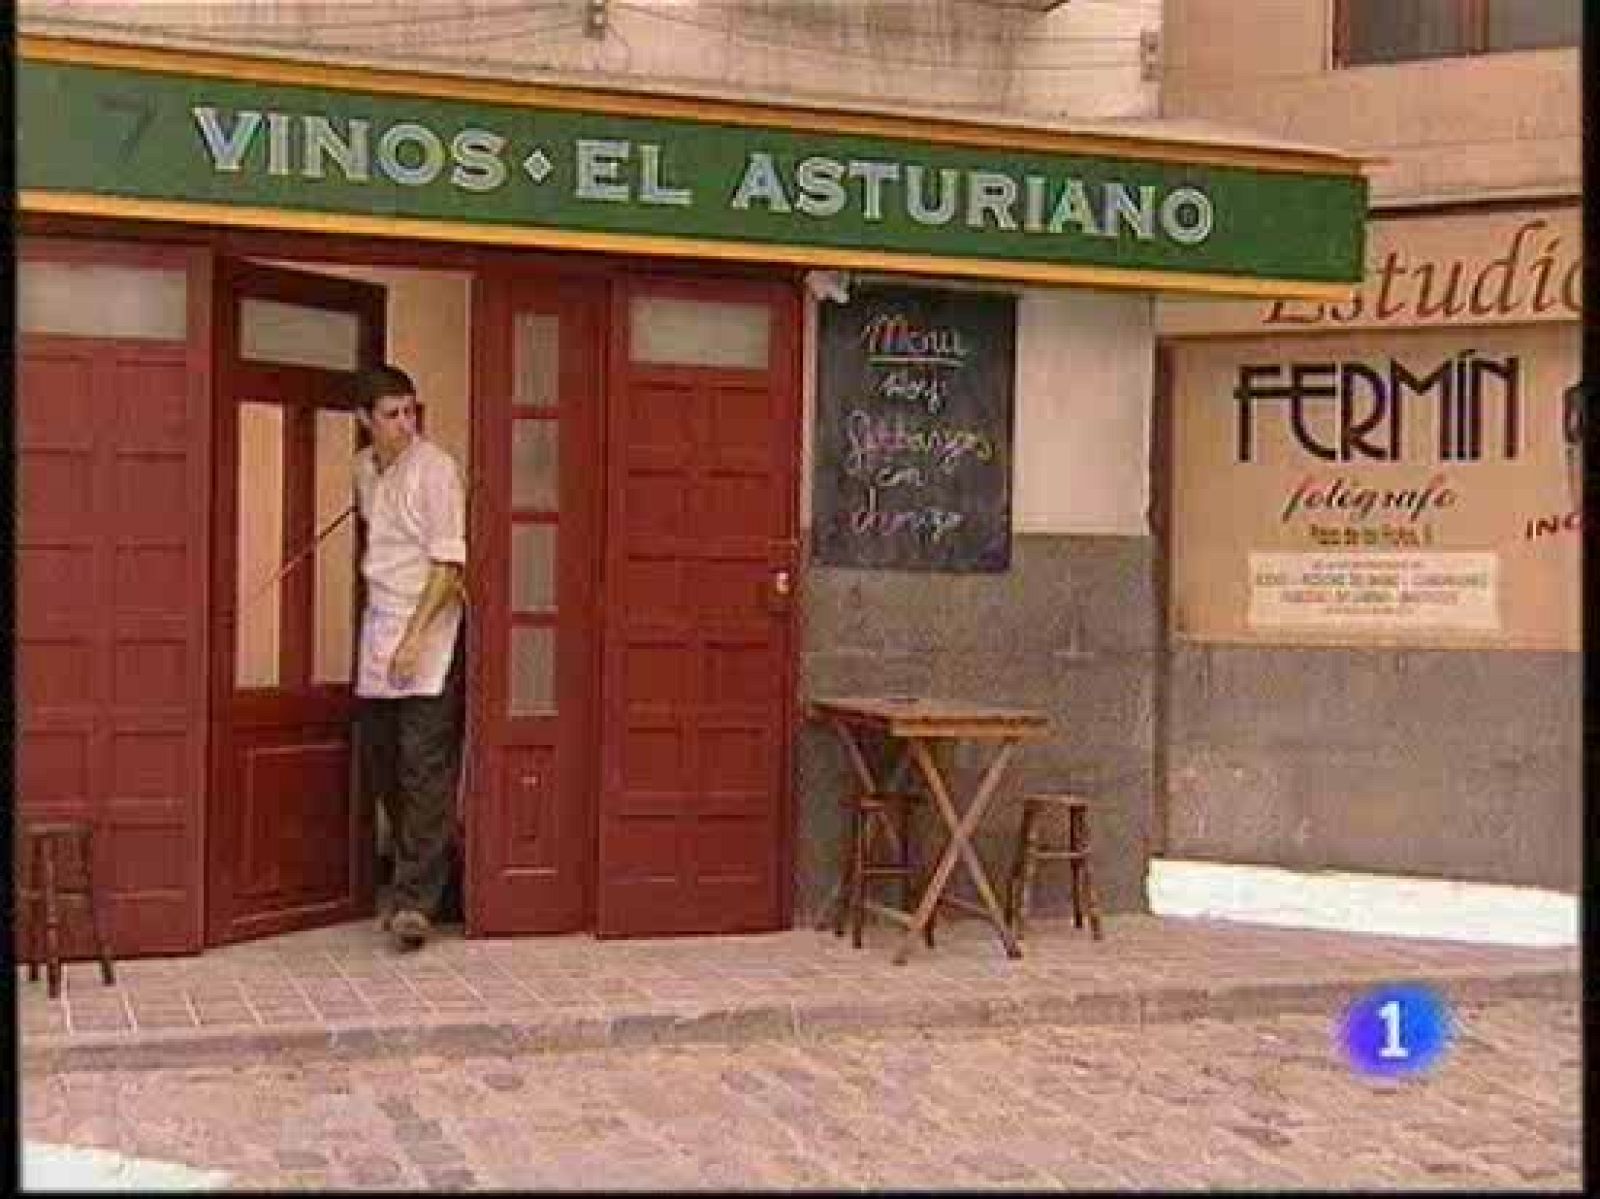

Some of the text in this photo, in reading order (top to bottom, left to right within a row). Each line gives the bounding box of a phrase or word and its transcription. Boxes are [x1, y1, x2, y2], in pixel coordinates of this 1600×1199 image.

[193, 105, 1214, 245] VINOS EL ASTURIANO
[1233, 348, 1519, 462] FERMÍN
